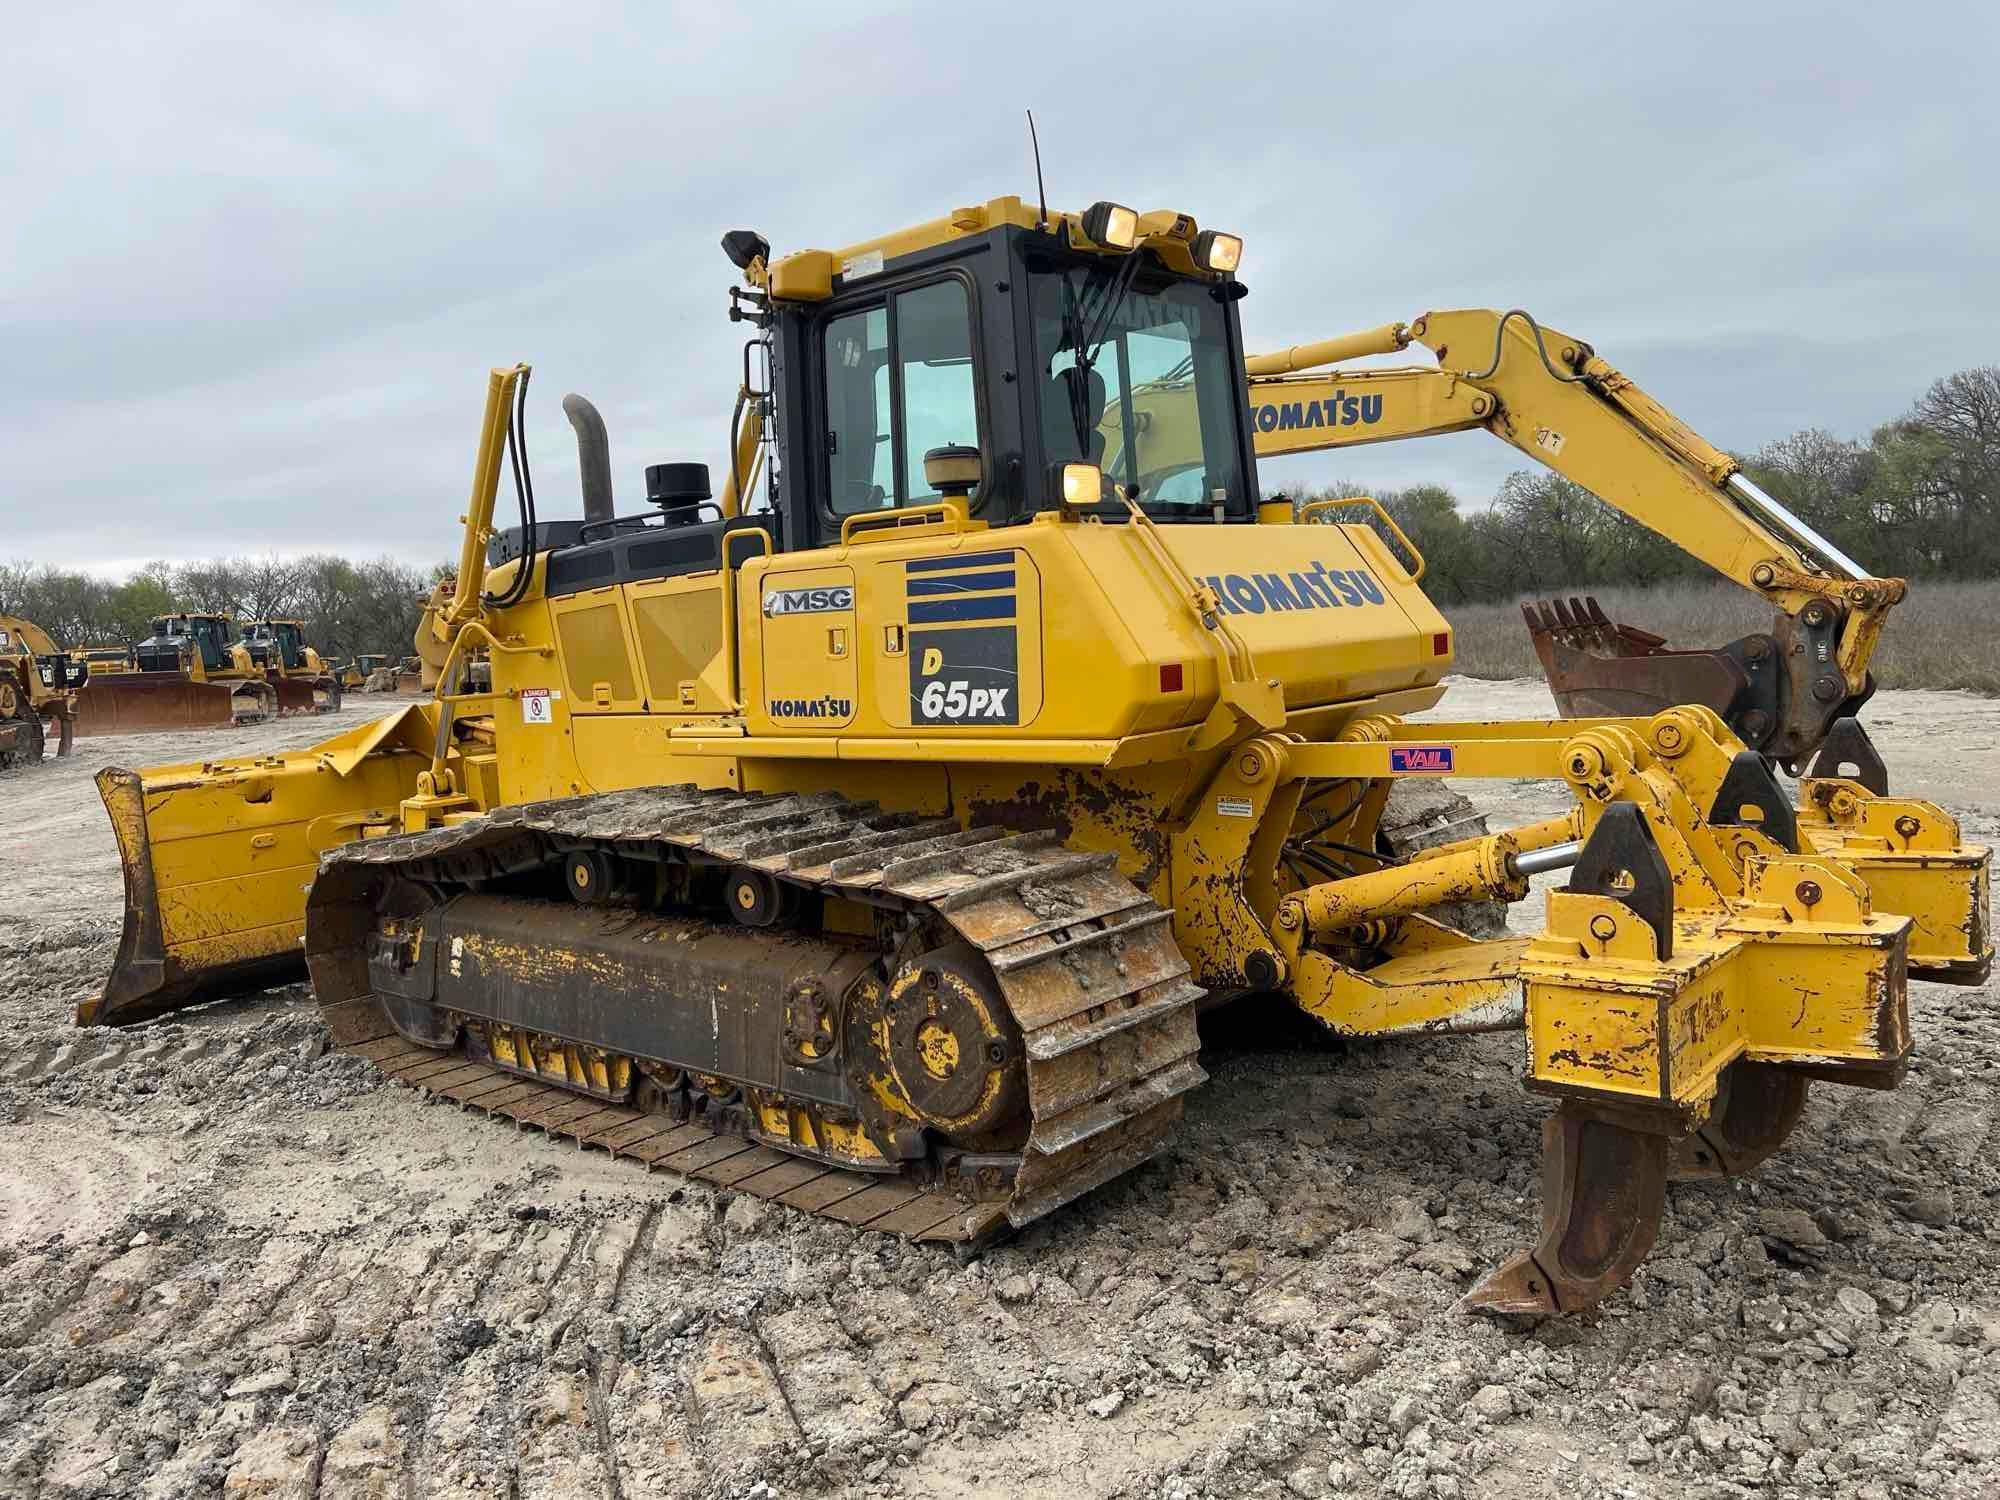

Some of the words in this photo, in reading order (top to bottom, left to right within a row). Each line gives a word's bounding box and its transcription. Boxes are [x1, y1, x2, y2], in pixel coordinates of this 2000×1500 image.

[65, 668, 79, 676] CAT
[921, 648, 943, 676] D
[770, 694, 851, 717] KOMATSU
[921, 680, 1009, 719] 65PX
[1394, 750, 1449, 769] VAIL
